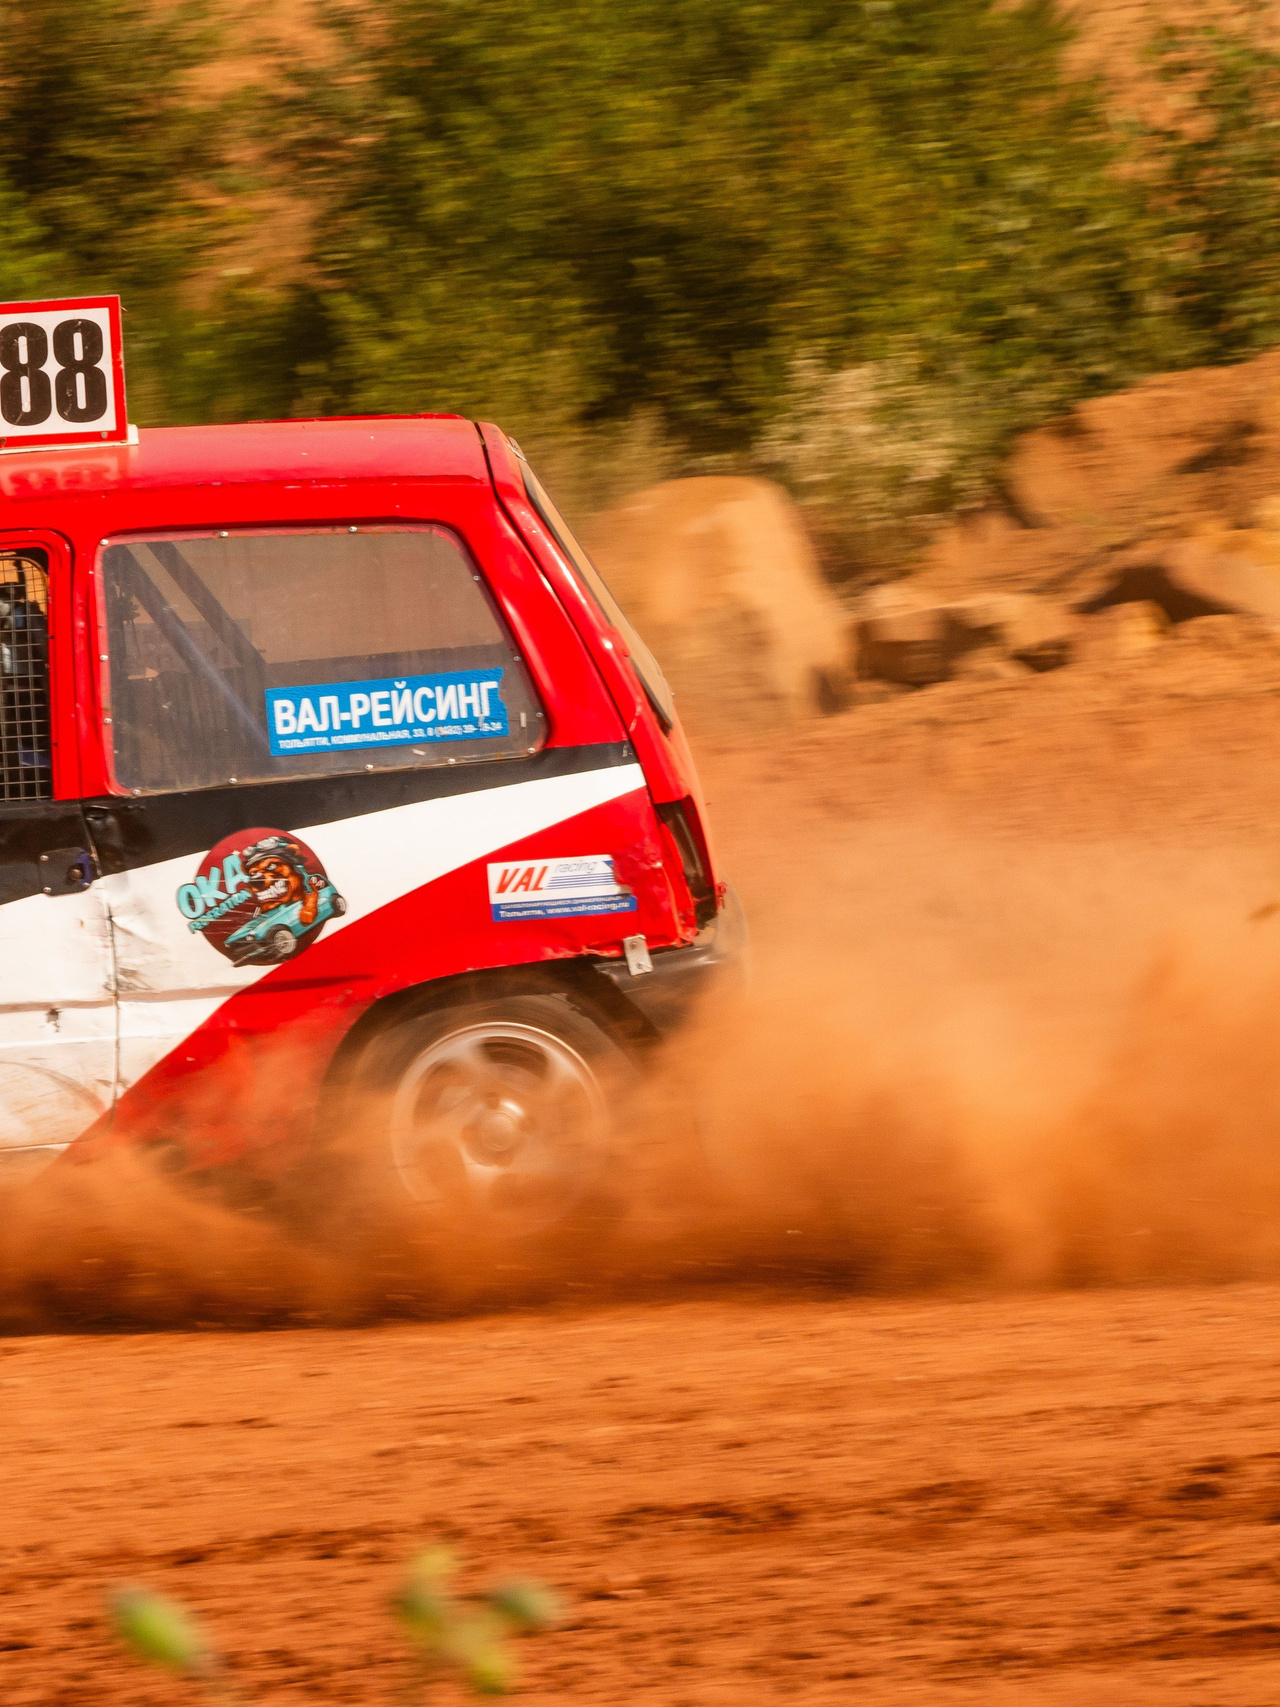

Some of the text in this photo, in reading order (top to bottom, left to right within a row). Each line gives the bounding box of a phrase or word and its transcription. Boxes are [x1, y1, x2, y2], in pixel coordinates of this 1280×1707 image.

[273, 680, 499, 735] ВАЛ-РЕЙСИНГ
[176, 853, 251, 920] OKA
[495, 865, 549, 895] VAL
[553, 860, 599, 874] racing
